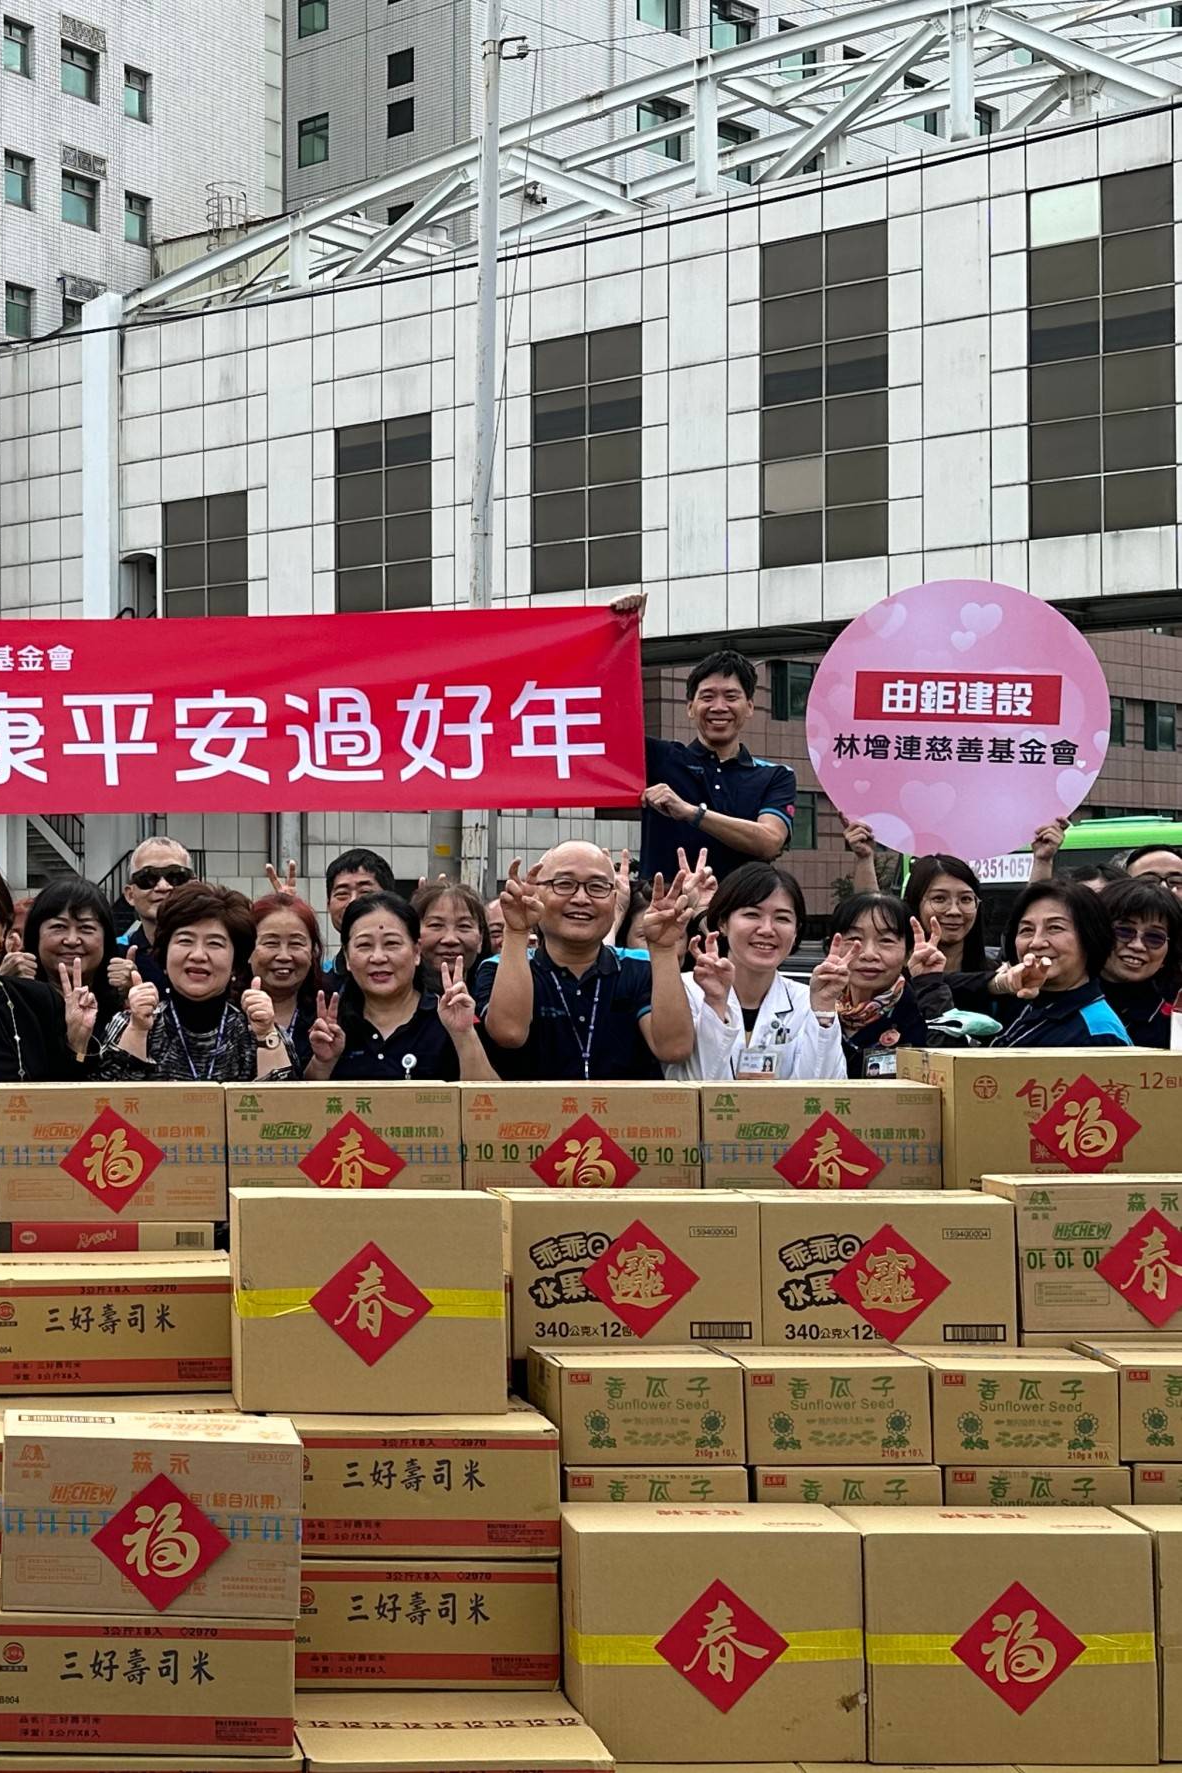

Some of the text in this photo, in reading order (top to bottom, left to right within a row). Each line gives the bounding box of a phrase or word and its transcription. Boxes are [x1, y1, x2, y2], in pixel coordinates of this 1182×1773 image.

[881, 679, 1033, 718] 由鉅建設
[833, 733, 1079, 766] 林增連慈善基金會
[737, 1122, 790, 1139] HI-CHEW
[1055, 1096, 1118, 1158] 福
[83, 1128, 144, 1189] 福
[320, 1128, 391, 1188] 春
[476, 1143, 494, 1160] 10
[502, 1144, 519, 1161] 10
[656, 1147, 673, 1163] 10
[554, 1136, 616, 1188] 福
[797, 1128, 870, 1189] 春
[1053, 1221, 1112, 1240] HI-CHEW
[1120, 1227, 1182, 1300] 春
[333, 1260, 416, 1338] 春
[45, 1304, 175, 1335] 三好壽司米
[605, 1377, 711, 1398] 香瓜子
[788, 1376, 895, 1399] 香瓜子
[978, 1379, 1084, 1401] 香瓜子
[607, 1399, 709, 1411] Sunflower Seed
[791, 1398, 894, 1411] Sunflower Seed
[980, 1402, 1082, 1413] Sunflower Seed
[342, 1458, 486, 1492] 三好壽司米
[608, 1480, 714, 1502] 香瓜子
[801, 1479, 909, 1501] 香瓜子
[988, 1476, 1096, 1498] 香瓜子
[50, 1481, 117, 1505] HI-CHEW
[122, 1502, 201, 1578] 福
[347, 1592, 490, 1625] 三好壽司米
[683, 1600, 770, 1683] 春
[981, 1610, 1057, 1683] 福
[60, 1648, 215, 1685] 三好壽司米
